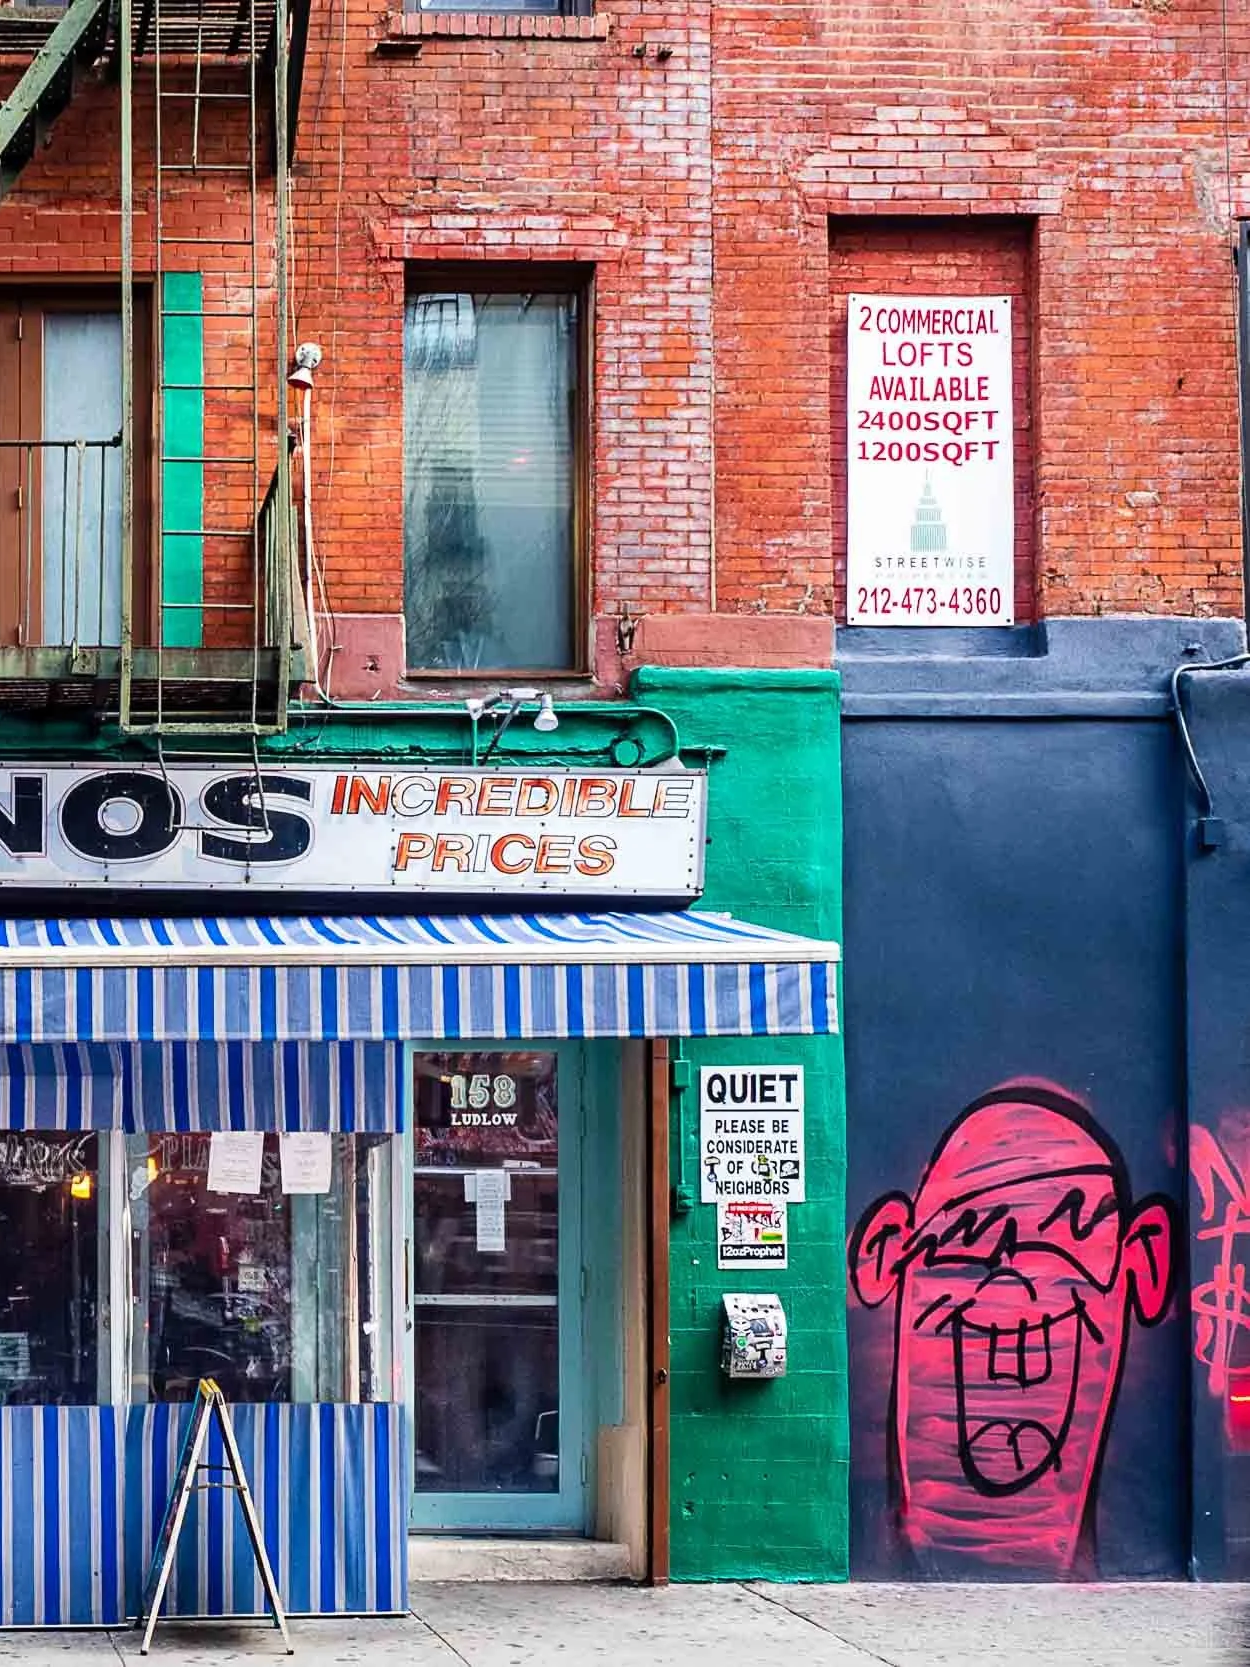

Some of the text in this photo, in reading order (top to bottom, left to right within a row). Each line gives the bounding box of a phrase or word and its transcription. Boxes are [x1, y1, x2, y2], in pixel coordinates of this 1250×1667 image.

[860, 306, 999, 335] 2 COMMERCIAL
[882, 342, 973, 367] LOFTS
[869, 376, 990, 401] AVAILABLE
[857, 411, 999, 436] 2400SQFT
[857, 441, 1000, 466] 1200SQFT
[874, 557, 987, 568] STREETWISE
[858, 587, 1001, 614] 212-473-4360
[330, 775, 694, 818] INCREDIBLE
[394, 832, 617, 875] PRICES
[450, 1074, 516, 1108] 158
[707, 1073, 798, 1104] QUIET
[451, 1113, 518, 1126] LUDLOW
[715, 1119, 789, 1133] PLEASE BE
[707, 1139, 798, 1154] CONSIDERATE
[727, 1160, 743, 1175] OF
[715, 1180, 790, 1195] NEIGHBORS
